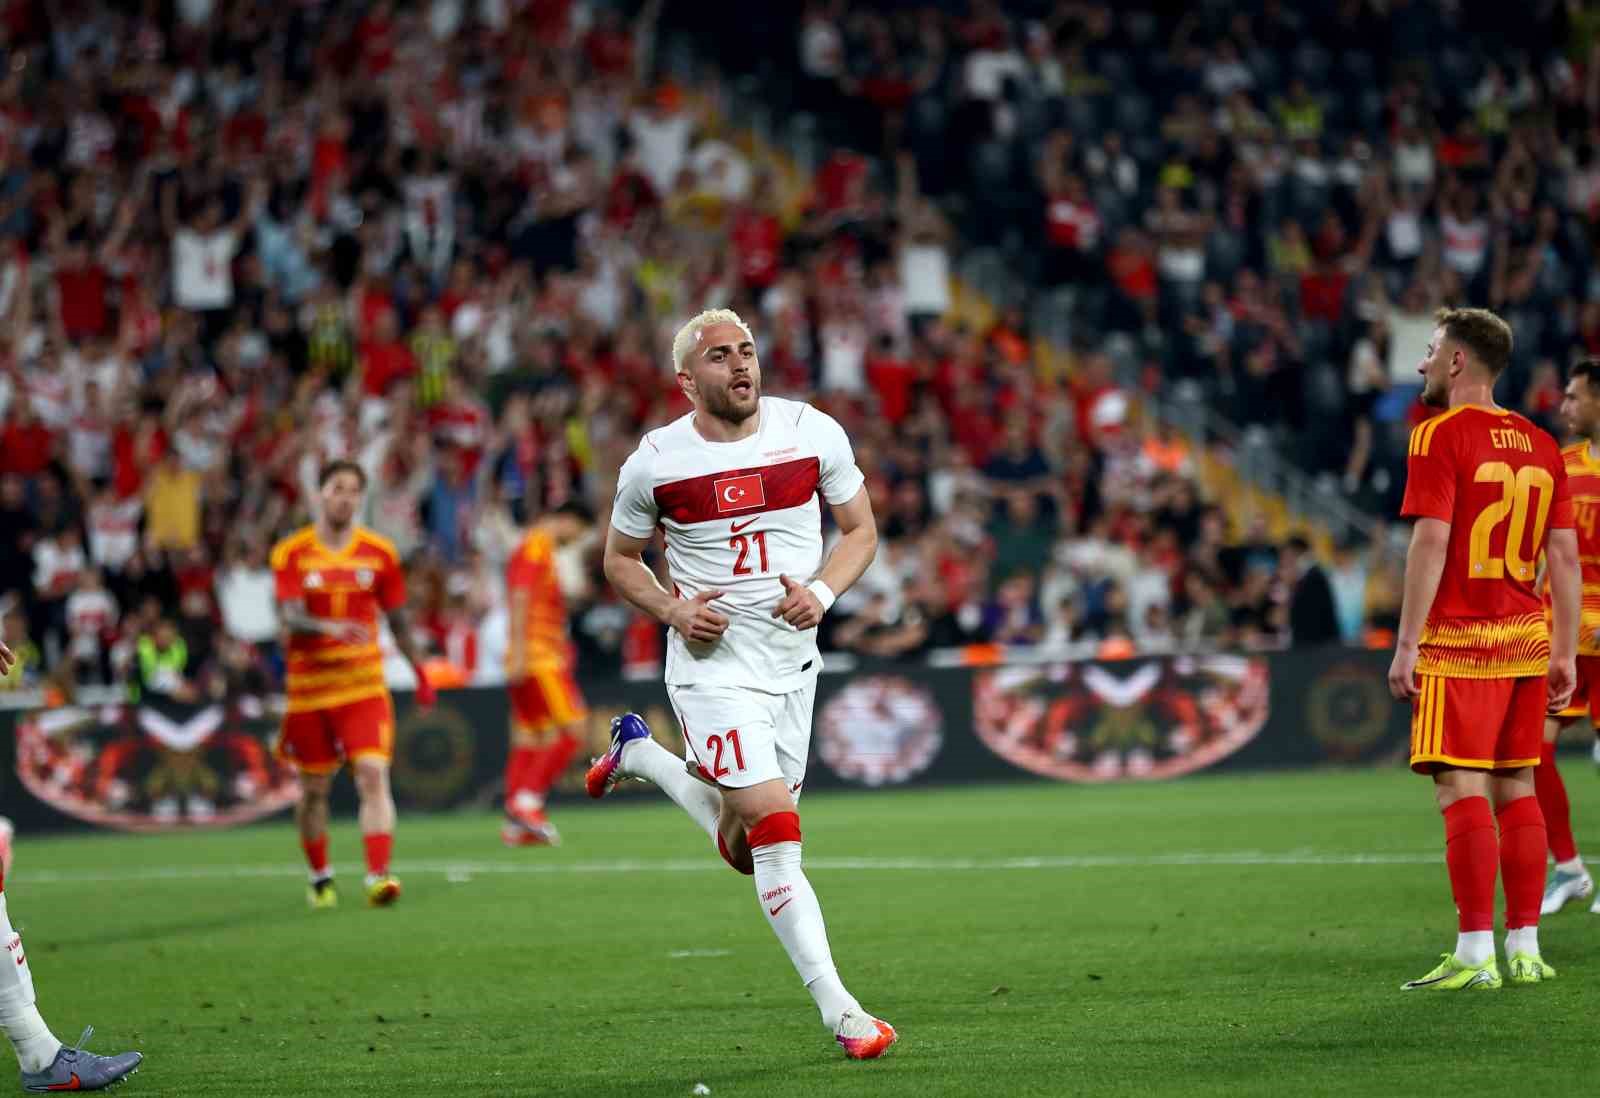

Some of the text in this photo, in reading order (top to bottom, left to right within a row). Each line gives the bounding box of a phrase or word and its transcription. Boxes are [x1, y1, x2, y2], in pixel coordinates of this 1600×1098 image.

[1469, 461, 1554, 582] 20
[729, 530, 770, 577] 21
[707, 729, 745, 777] 21
